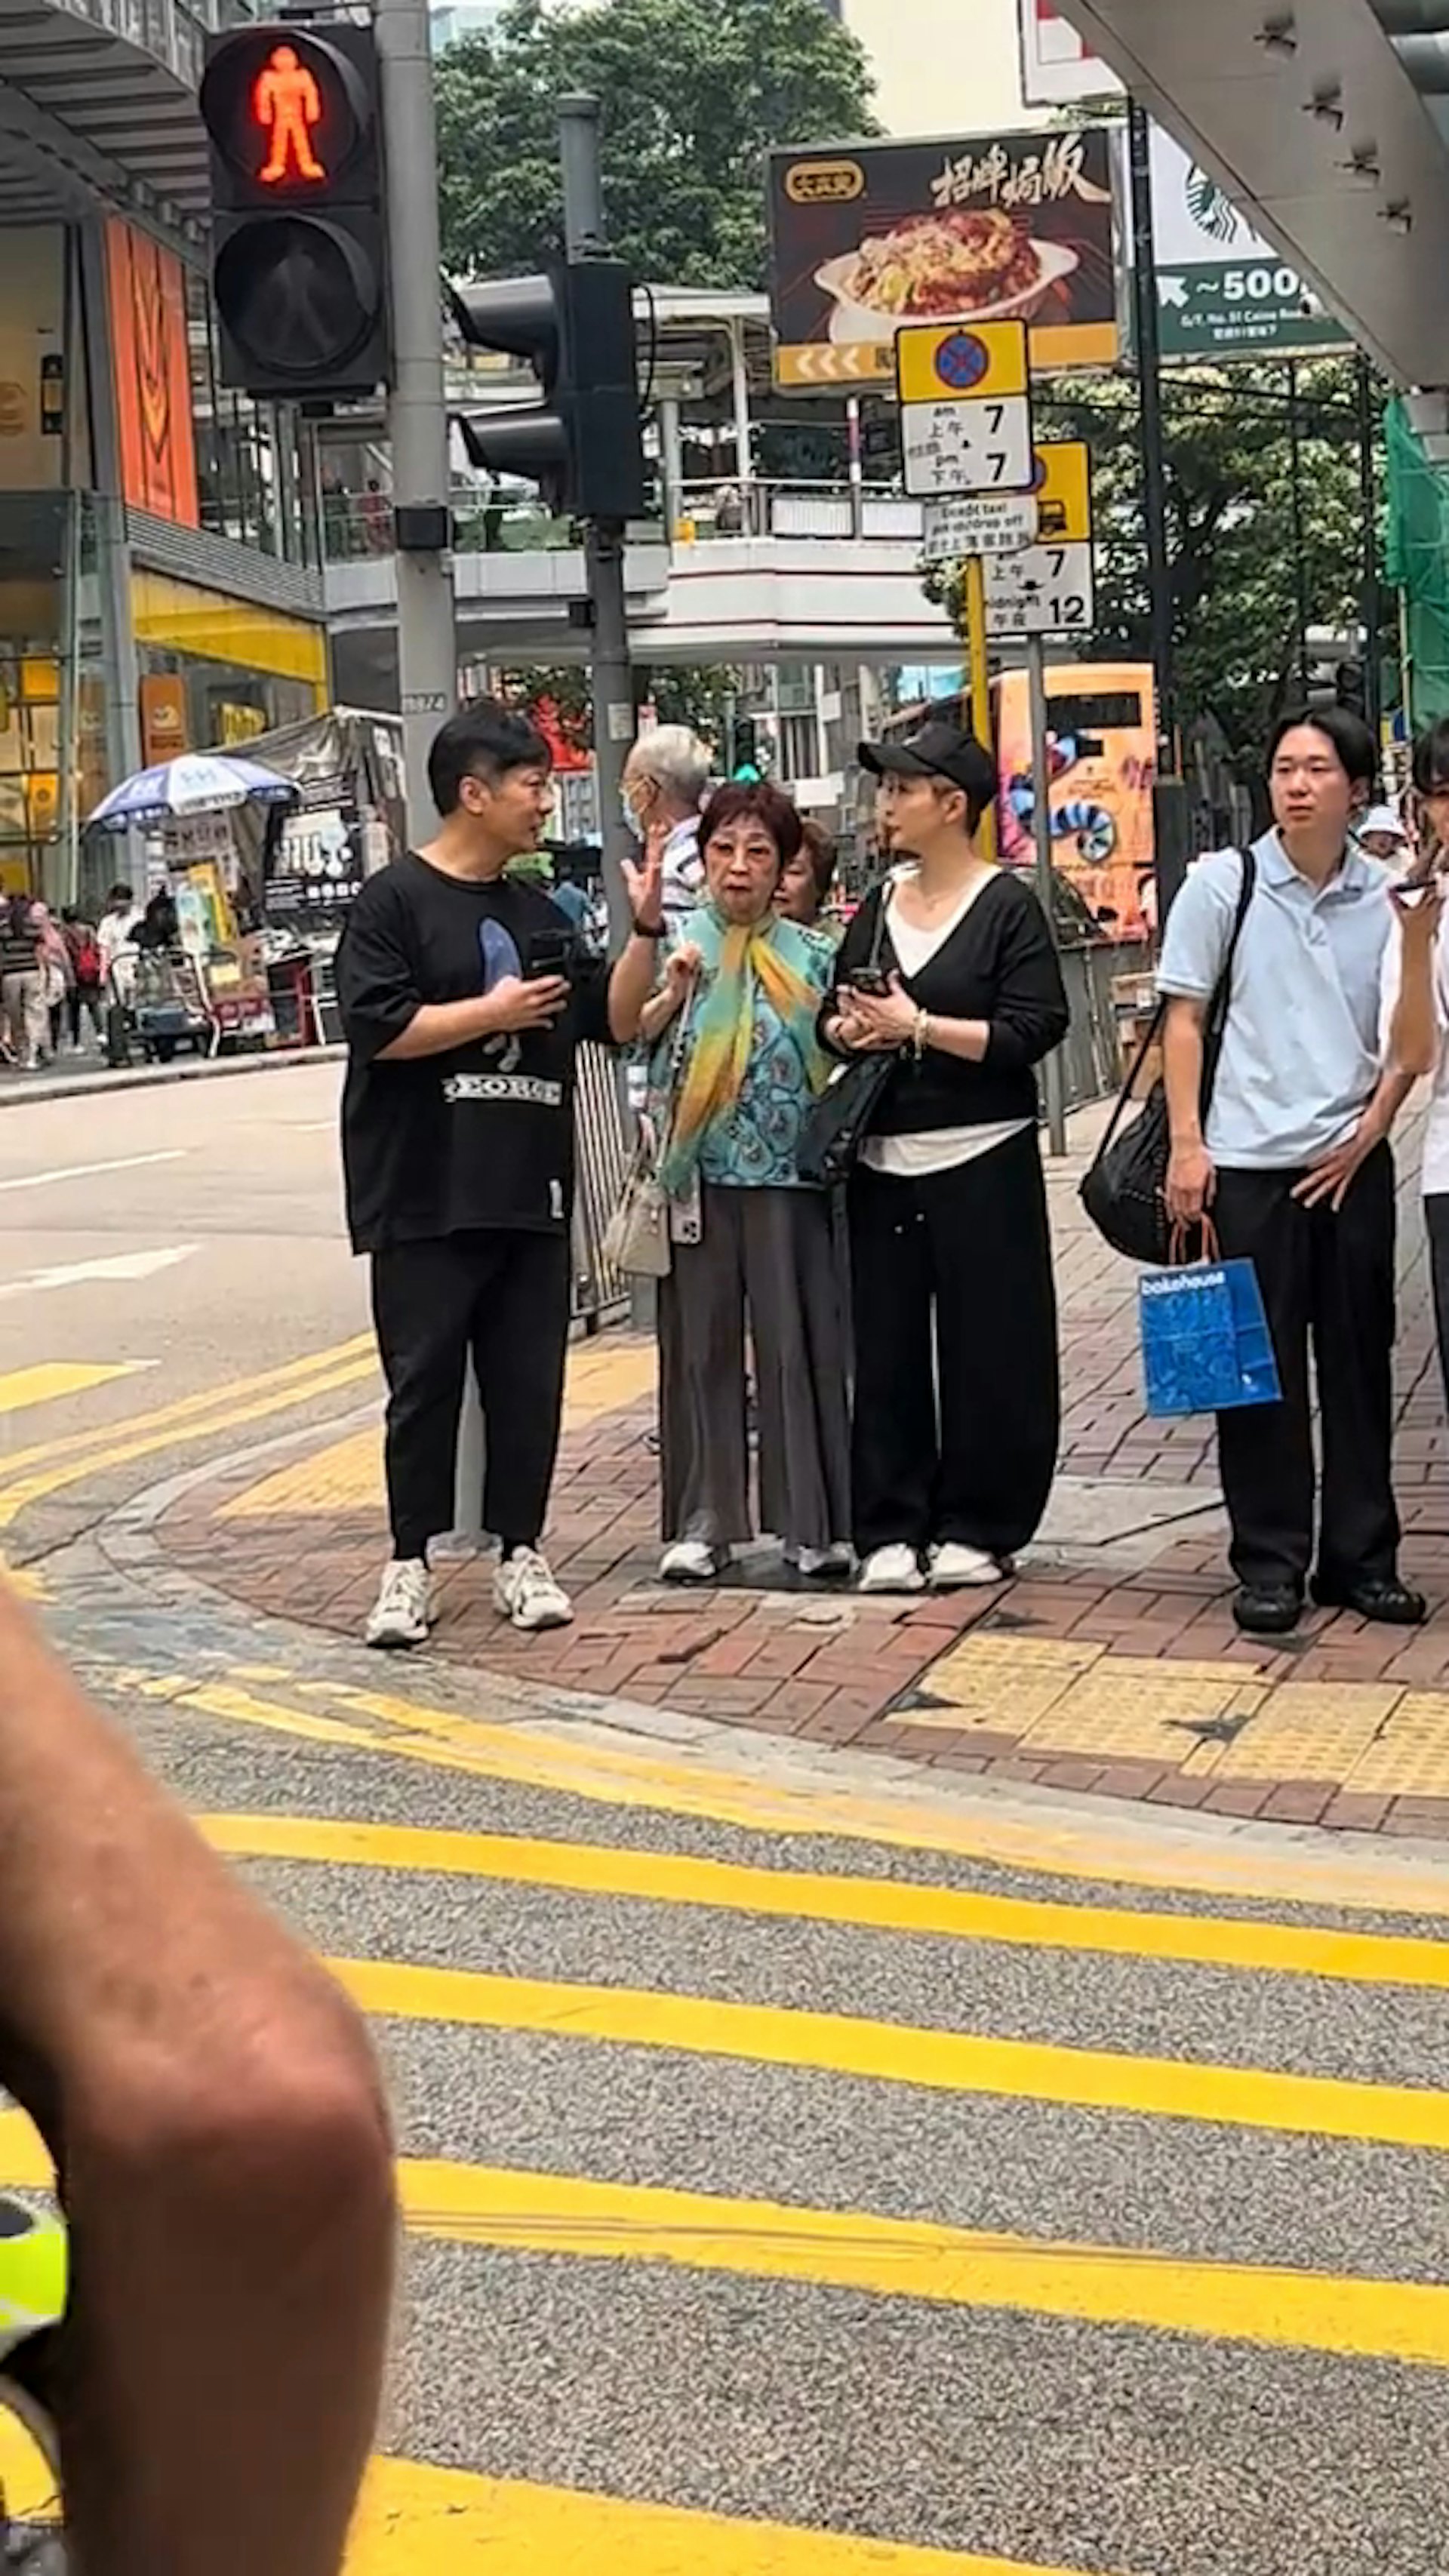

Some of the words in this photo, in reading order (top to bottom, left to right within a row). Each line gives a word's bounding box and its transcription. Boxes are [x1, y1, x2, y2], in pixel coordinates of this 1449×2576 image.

[931, 133, 1112, 209] 招牌焗飯
[934, 407, 957, 417] am
[984, 405, 1004, 434] 7
[929, 421, 964, 438] 上午
[936, 454, 959, 467] pm
[986, 452, 1006, 482] 7
[991, 565, 1024, 581] 上午
[1046, 549, 1066, 577] 7
[1049, 596, 1085, 624] 12
[1142, 1271, 1226, 1296] bakehouse
